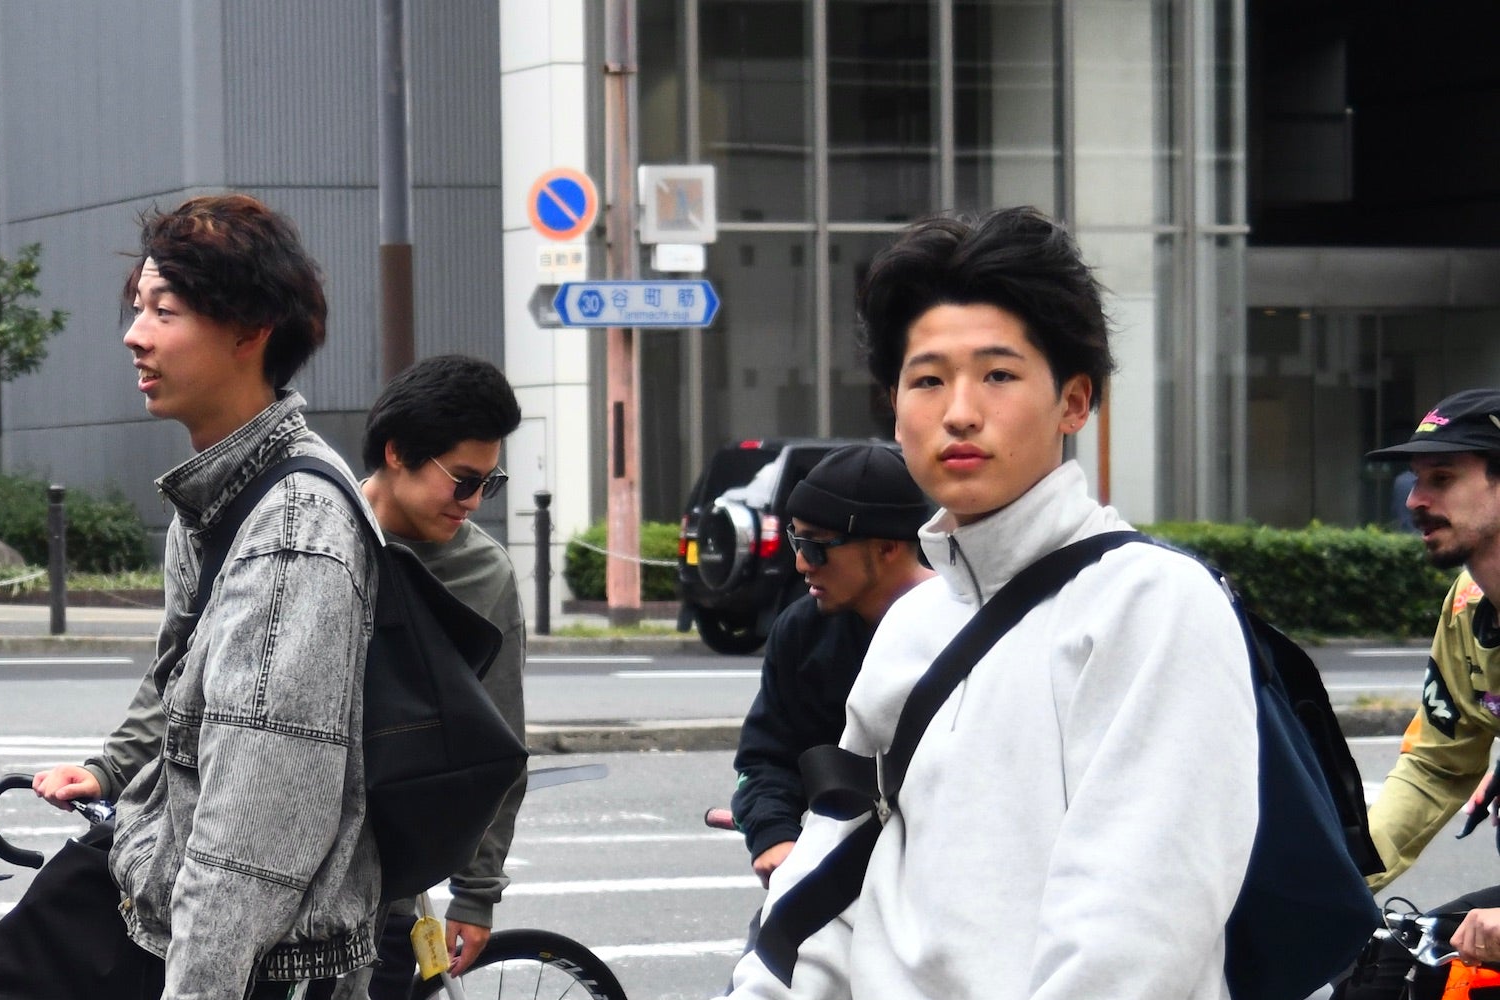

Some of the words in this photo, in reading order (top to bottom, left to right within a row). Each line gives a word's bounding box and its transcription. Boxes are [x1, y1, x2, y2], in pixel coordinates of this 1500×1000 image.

[580, 294, 600, 313] 30
[611, 287, 696, 308] 谷町筋
